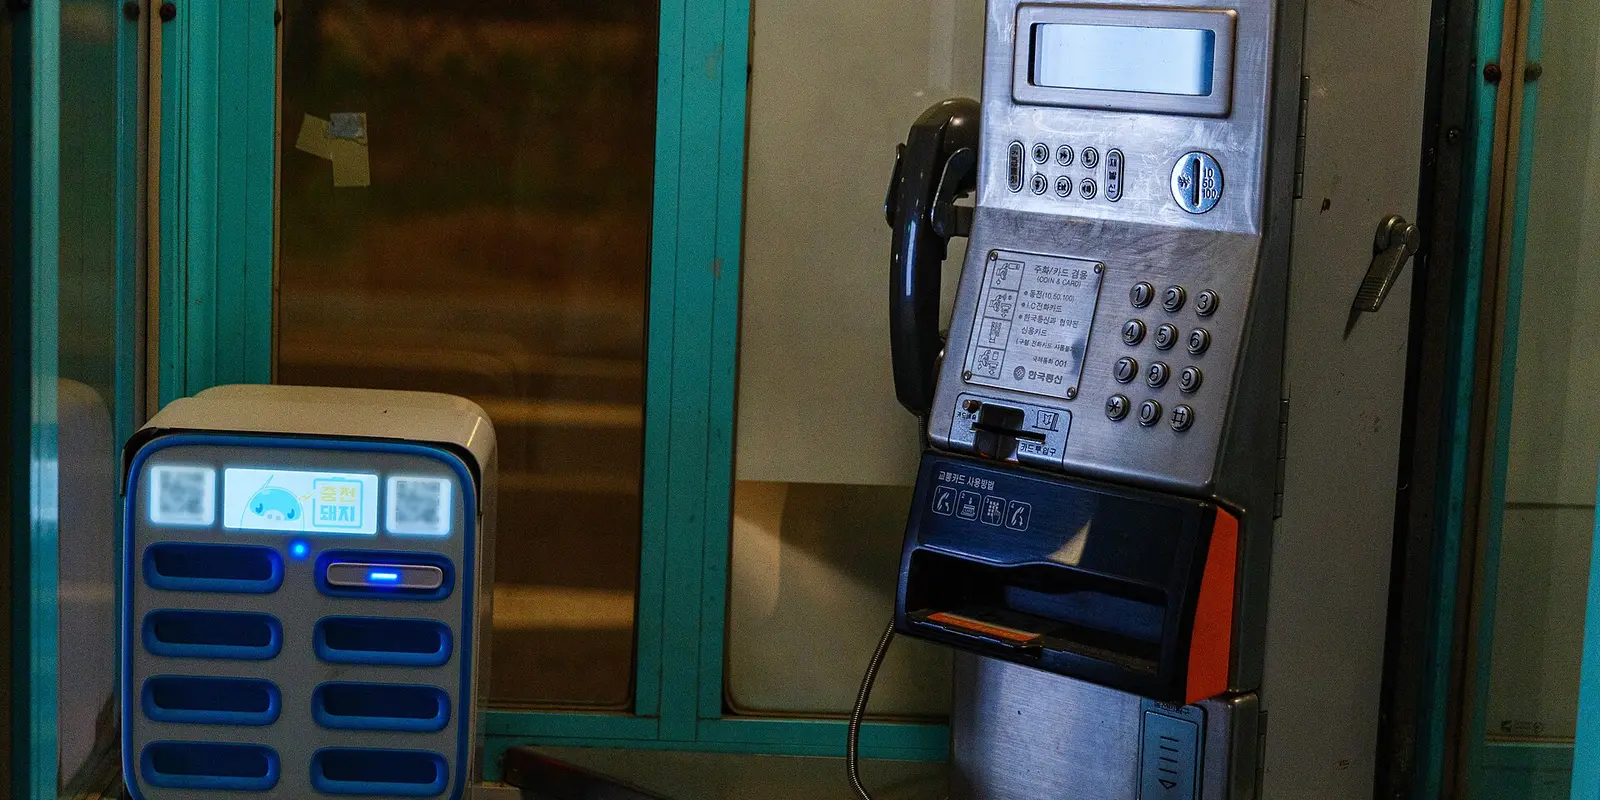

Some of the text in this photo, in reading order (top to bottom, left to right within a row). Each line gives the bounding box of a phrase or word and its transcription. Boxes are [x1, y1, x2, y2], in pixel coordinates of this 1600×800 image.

[1204, 168, 1215, 178] 10
[1203, 178, 1215, 189] 50
[1203, 188, 1218, 199] 100
[1034, 264, 1088, 280] 주화/카드 겸용
[1036, 275, 1054, 284] (COIN
[1062, 279, 1081, 288] CARD)
[1134, 286, 1209, 309] 1 2 3
[1021, 326, 1048, 336] 신용카드
[1125, 324, 1200, 349] 4 5 6
[1054, 359, 1068, 368] 001
[1027, 370, 1063, 385] 한국통신
[1118, 361, 1192, 386] 7 8 9
[1141, 404, 1151, 420] 0
[1020, 442, 1057, 455] 카드투입구
[938, 471, 995, 491] 교통카드 사용방법
[321, 486, 356, 503] 충전
[320, 505, 356, 522] 돼지
